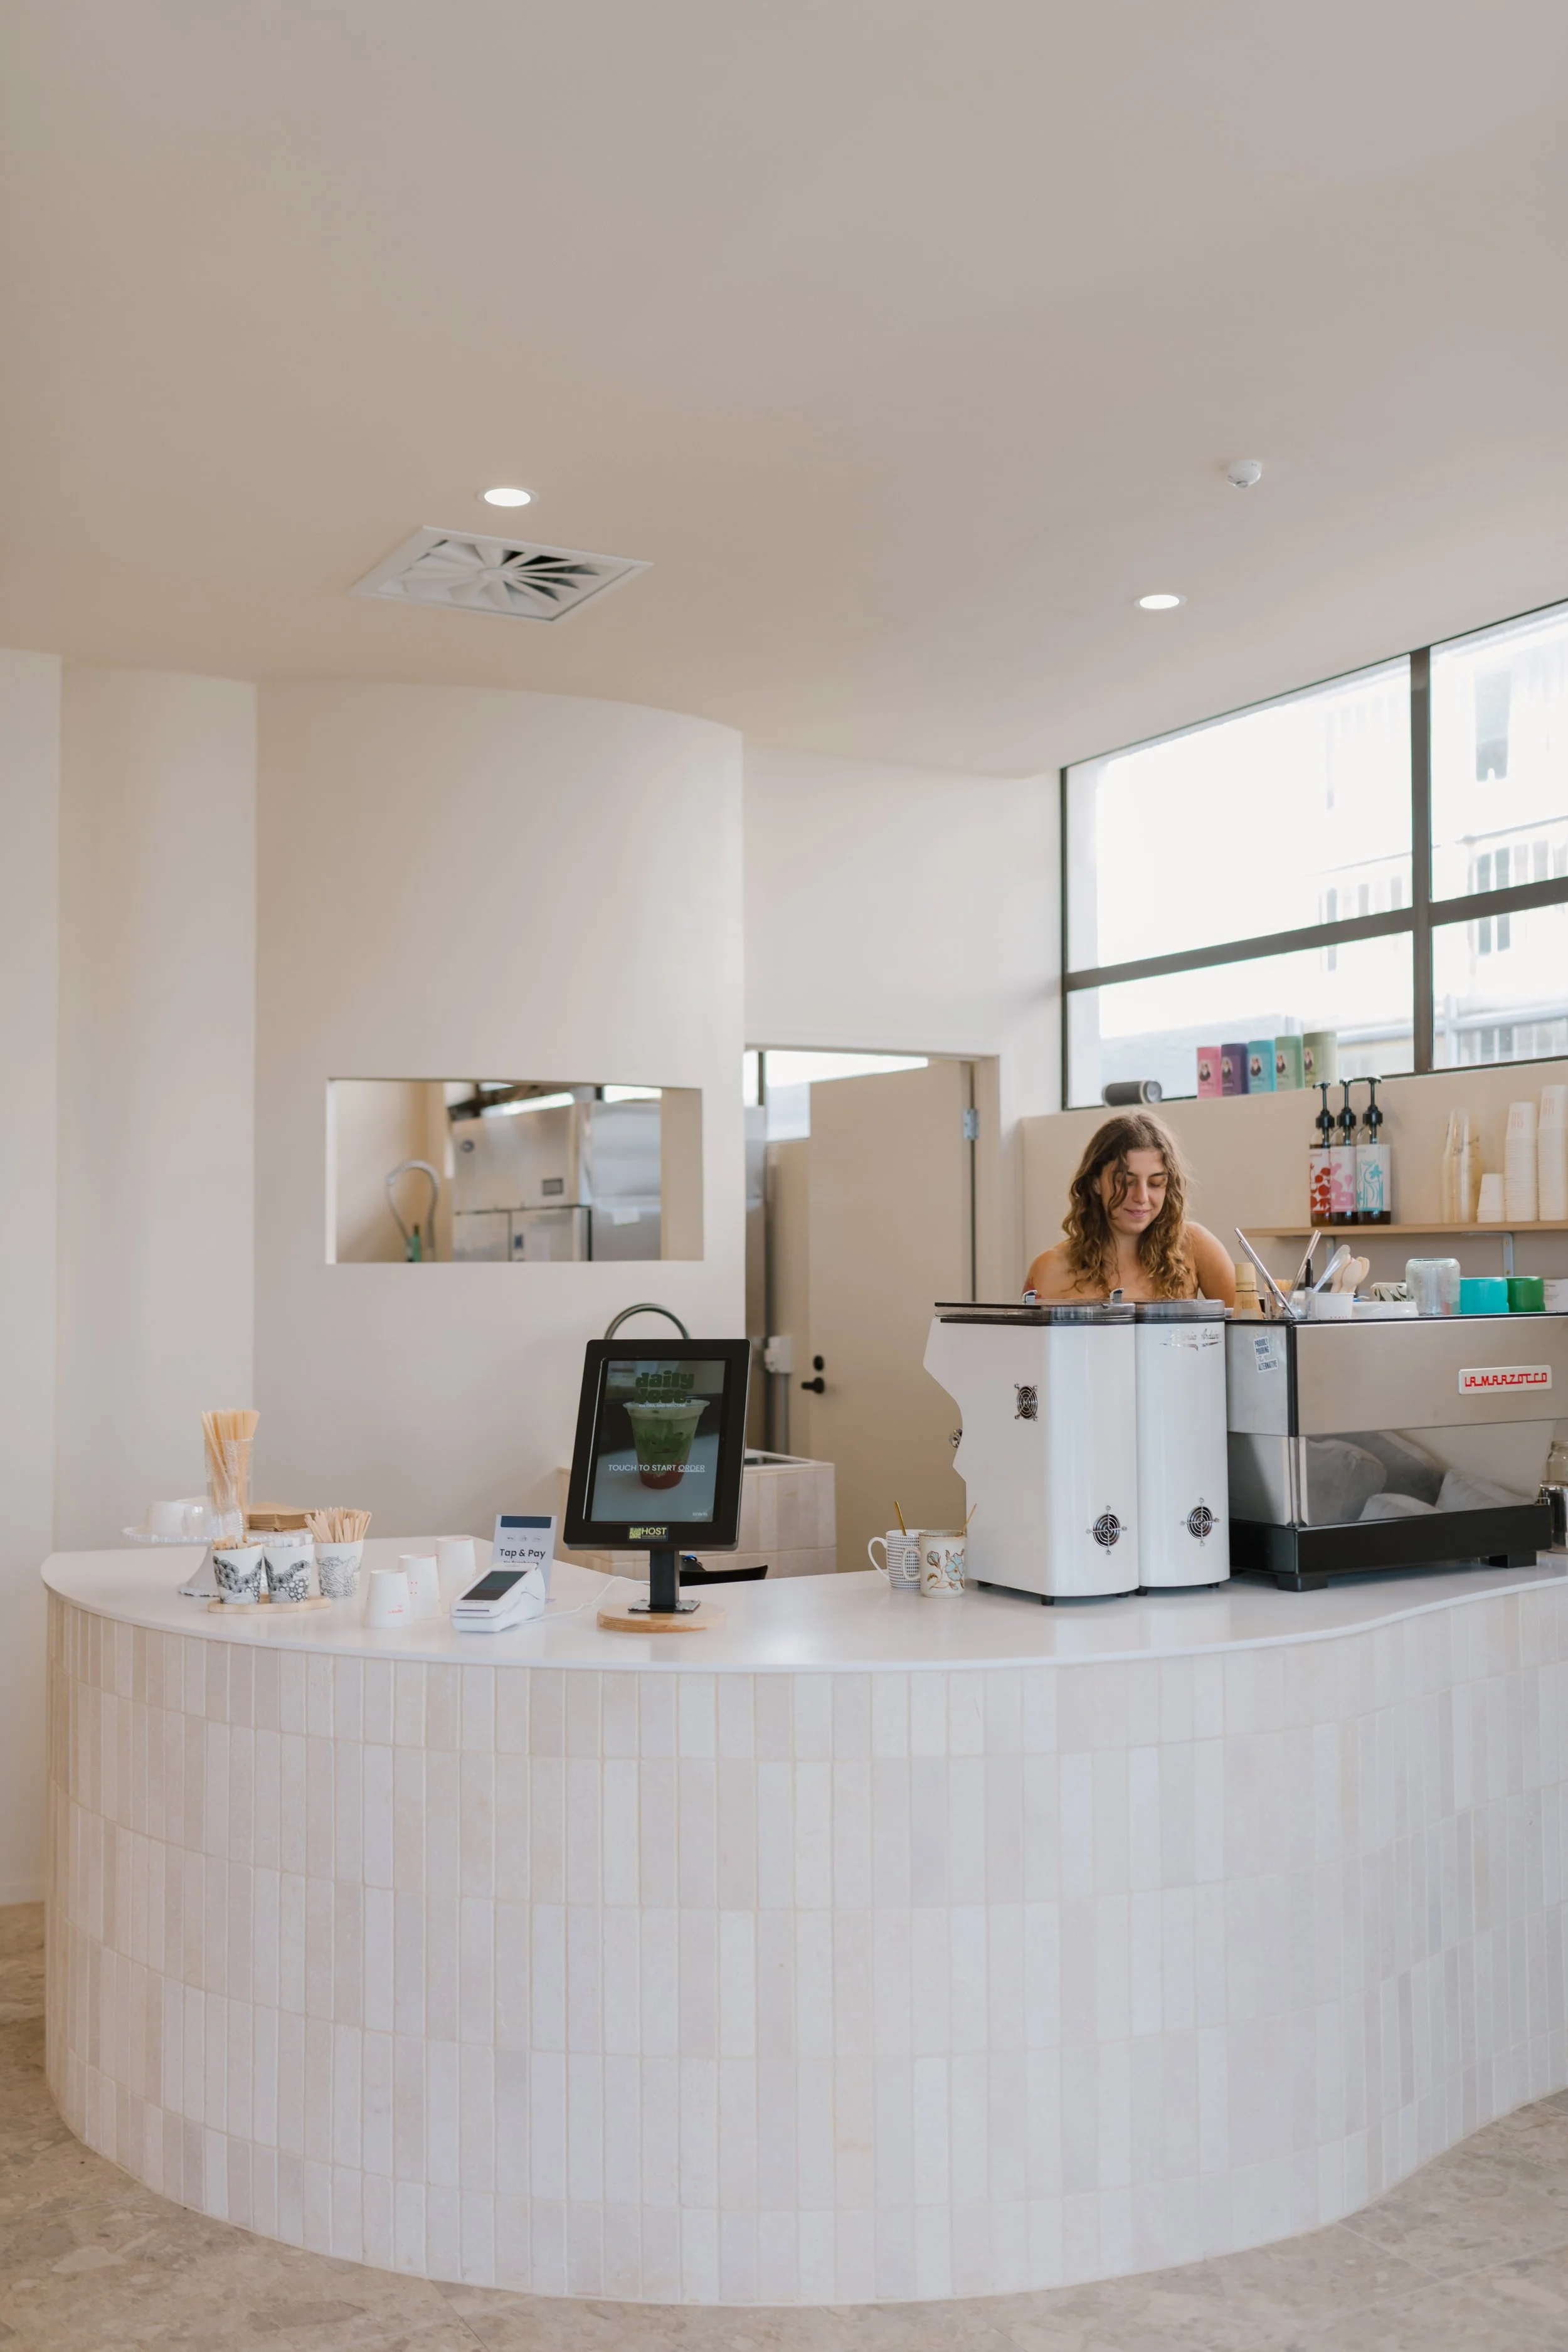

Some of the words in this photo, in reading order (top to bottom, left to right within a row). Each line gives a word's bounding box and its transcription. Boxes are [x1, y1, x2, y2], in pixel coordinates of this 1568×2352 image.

[635, 1370, 695, 1389] daily
[1465, 1377, 1475, 1387] LA
[641, 1527, 667, 1535] HOST
[500, 1549, 517, 1559] Tap
[527, 1549, 546, 1560] Pay
